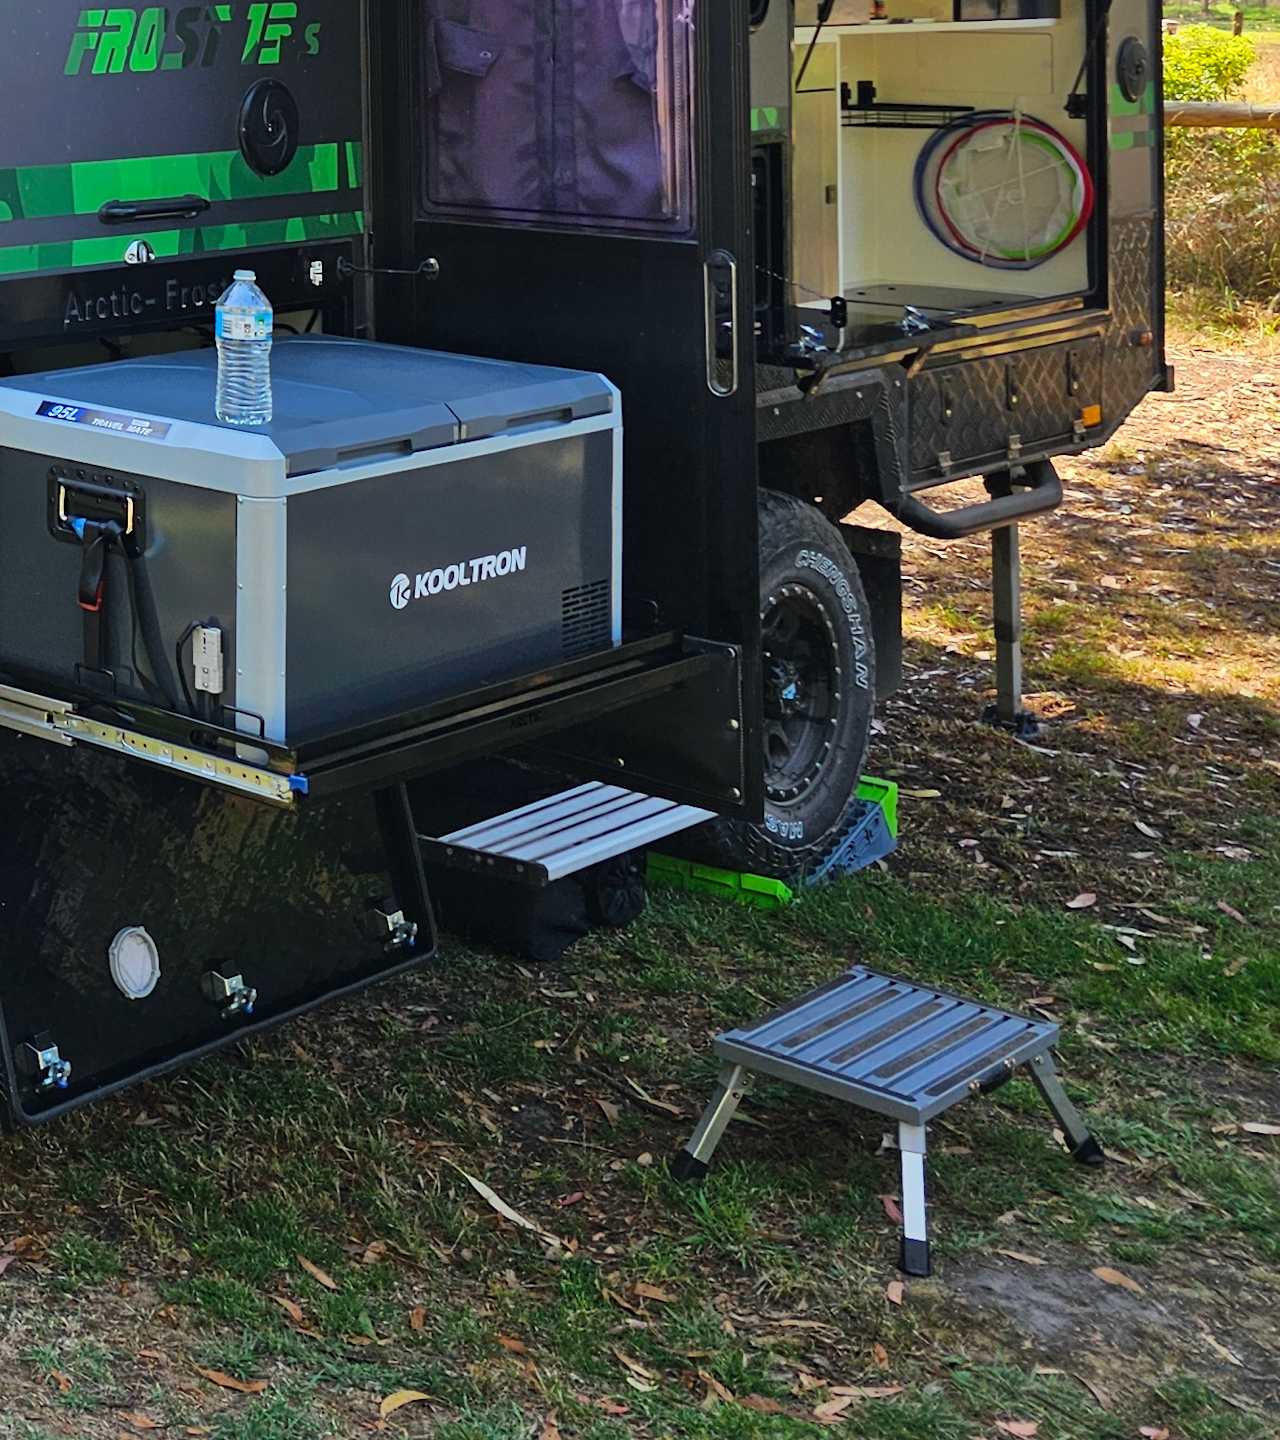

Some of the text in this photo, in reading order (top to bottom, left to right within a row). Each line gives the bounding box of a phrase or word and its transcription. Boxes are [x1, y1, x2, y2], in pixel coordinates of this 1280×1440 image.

[63, 3, 232, 76] FROST
[47, 405, 79, 422] 95L
[414, 546, 527, 599] KOOLTRON
[794, 549, 869, 690] CHENGSHAN
